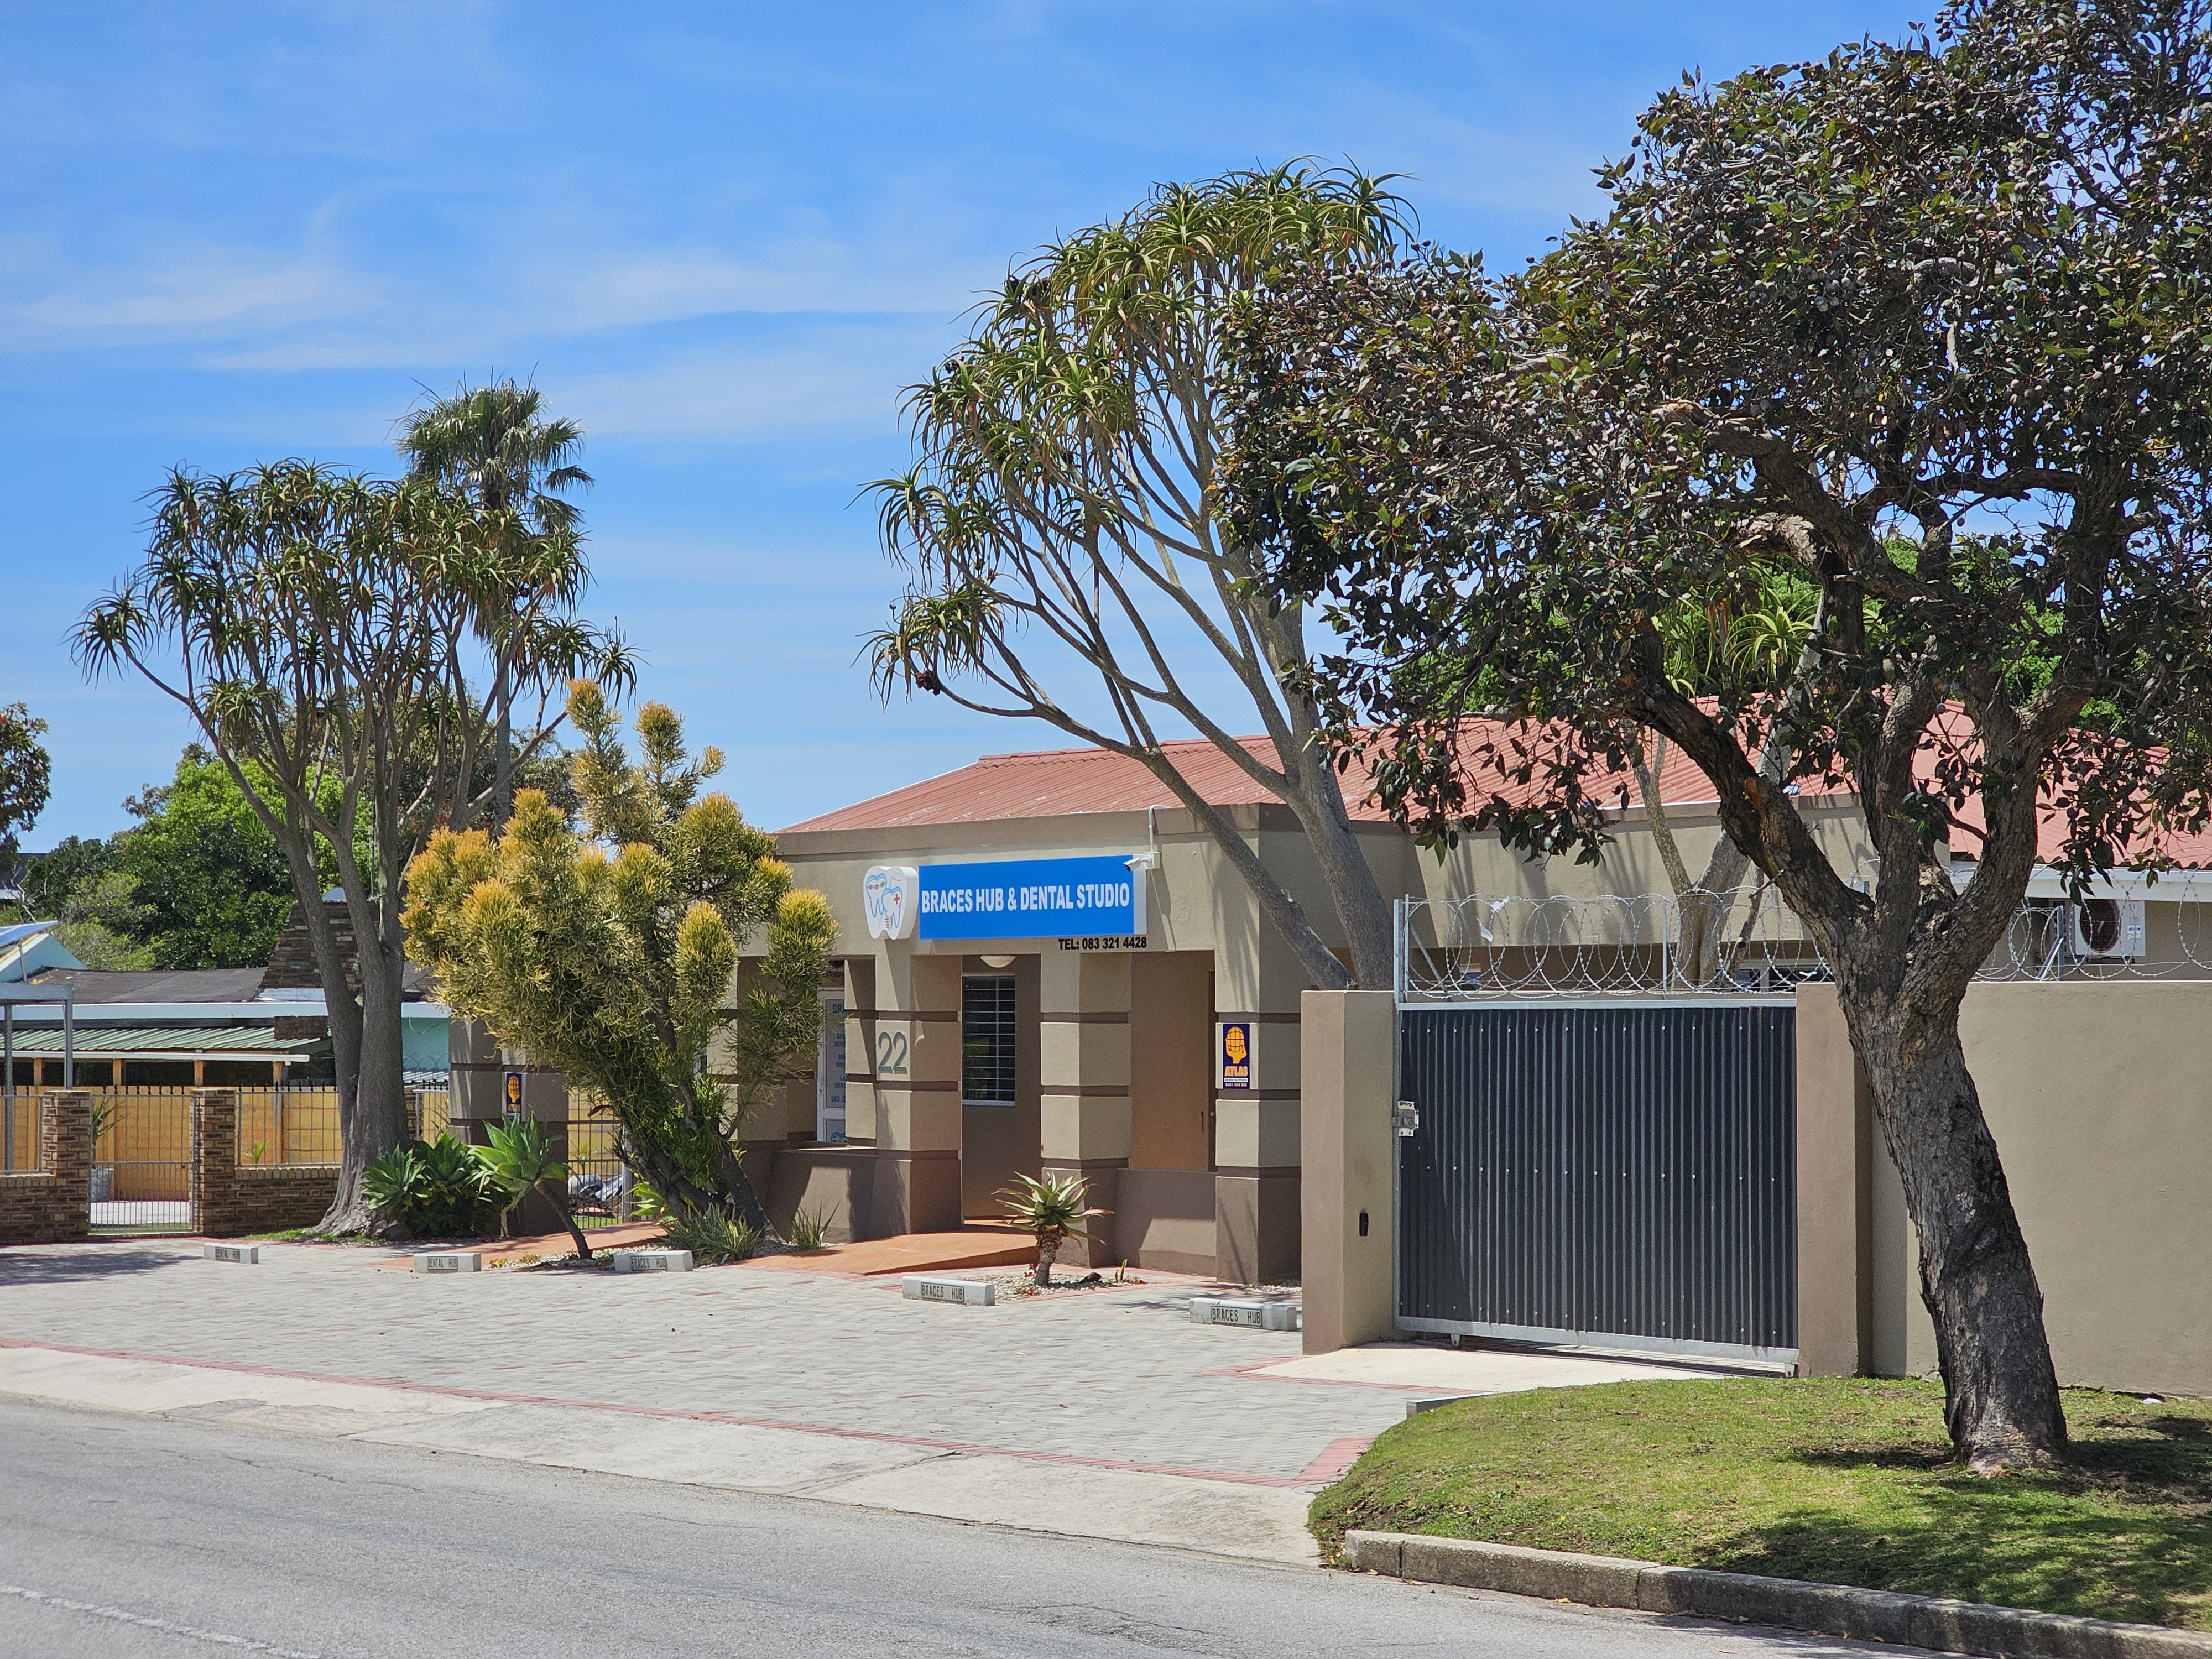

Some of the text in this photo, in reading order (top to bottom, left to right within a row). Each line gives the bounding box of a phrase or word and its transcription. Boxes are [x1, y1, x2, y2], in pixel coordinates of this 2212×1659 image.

[922, 883, 1129, 913] BRACES HUB & DENTAL STUDIO
[1058, 937, 1147, 950] TEL: 083 321 4428
[878, 1032, 907, 1074] 22
[1224, 1066, 1248, 1077] ATLAS
[631, 1257, 666, 1268] BRACES HUB
[922, 1285, 963, 1300] BRACES HUB
[1212, 1308, 1261, 1324] BRACES HUB
